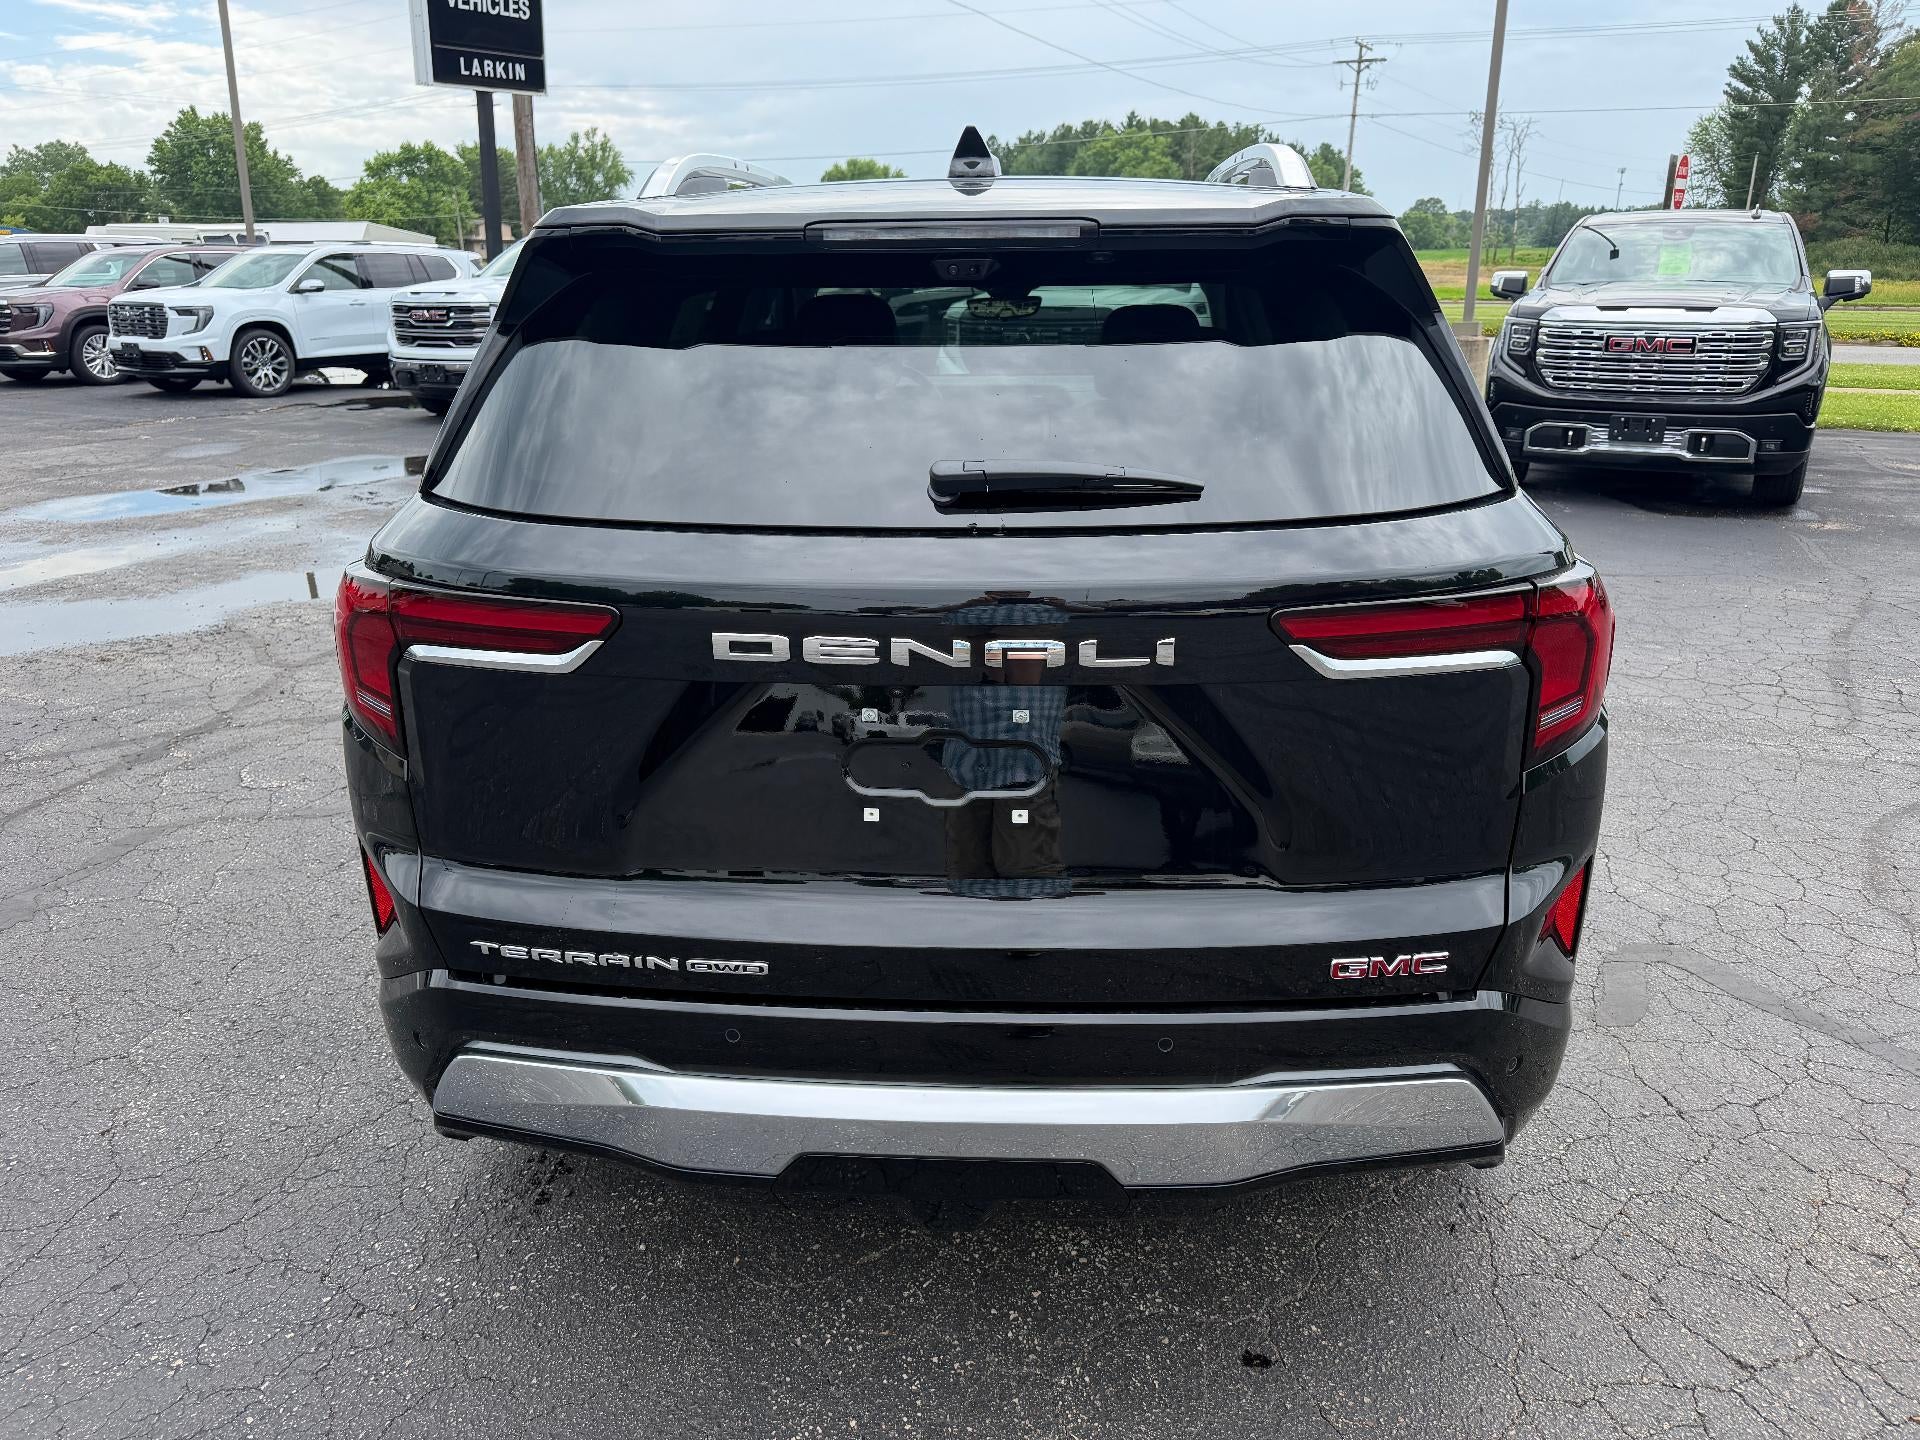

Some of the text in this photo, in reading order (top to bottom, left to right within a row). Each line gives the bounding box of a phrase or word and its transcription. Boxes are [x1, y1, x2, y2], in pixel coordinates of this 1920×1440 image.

[459, 56, 526, 81] LARKIN
[1608, 337, 1693, 353] GMC
[711, 632, 1176, 667] DENALI
[470, 940, 768, 975] TERRAIN AWD
[1330, 951, 1450, 980] GMC
